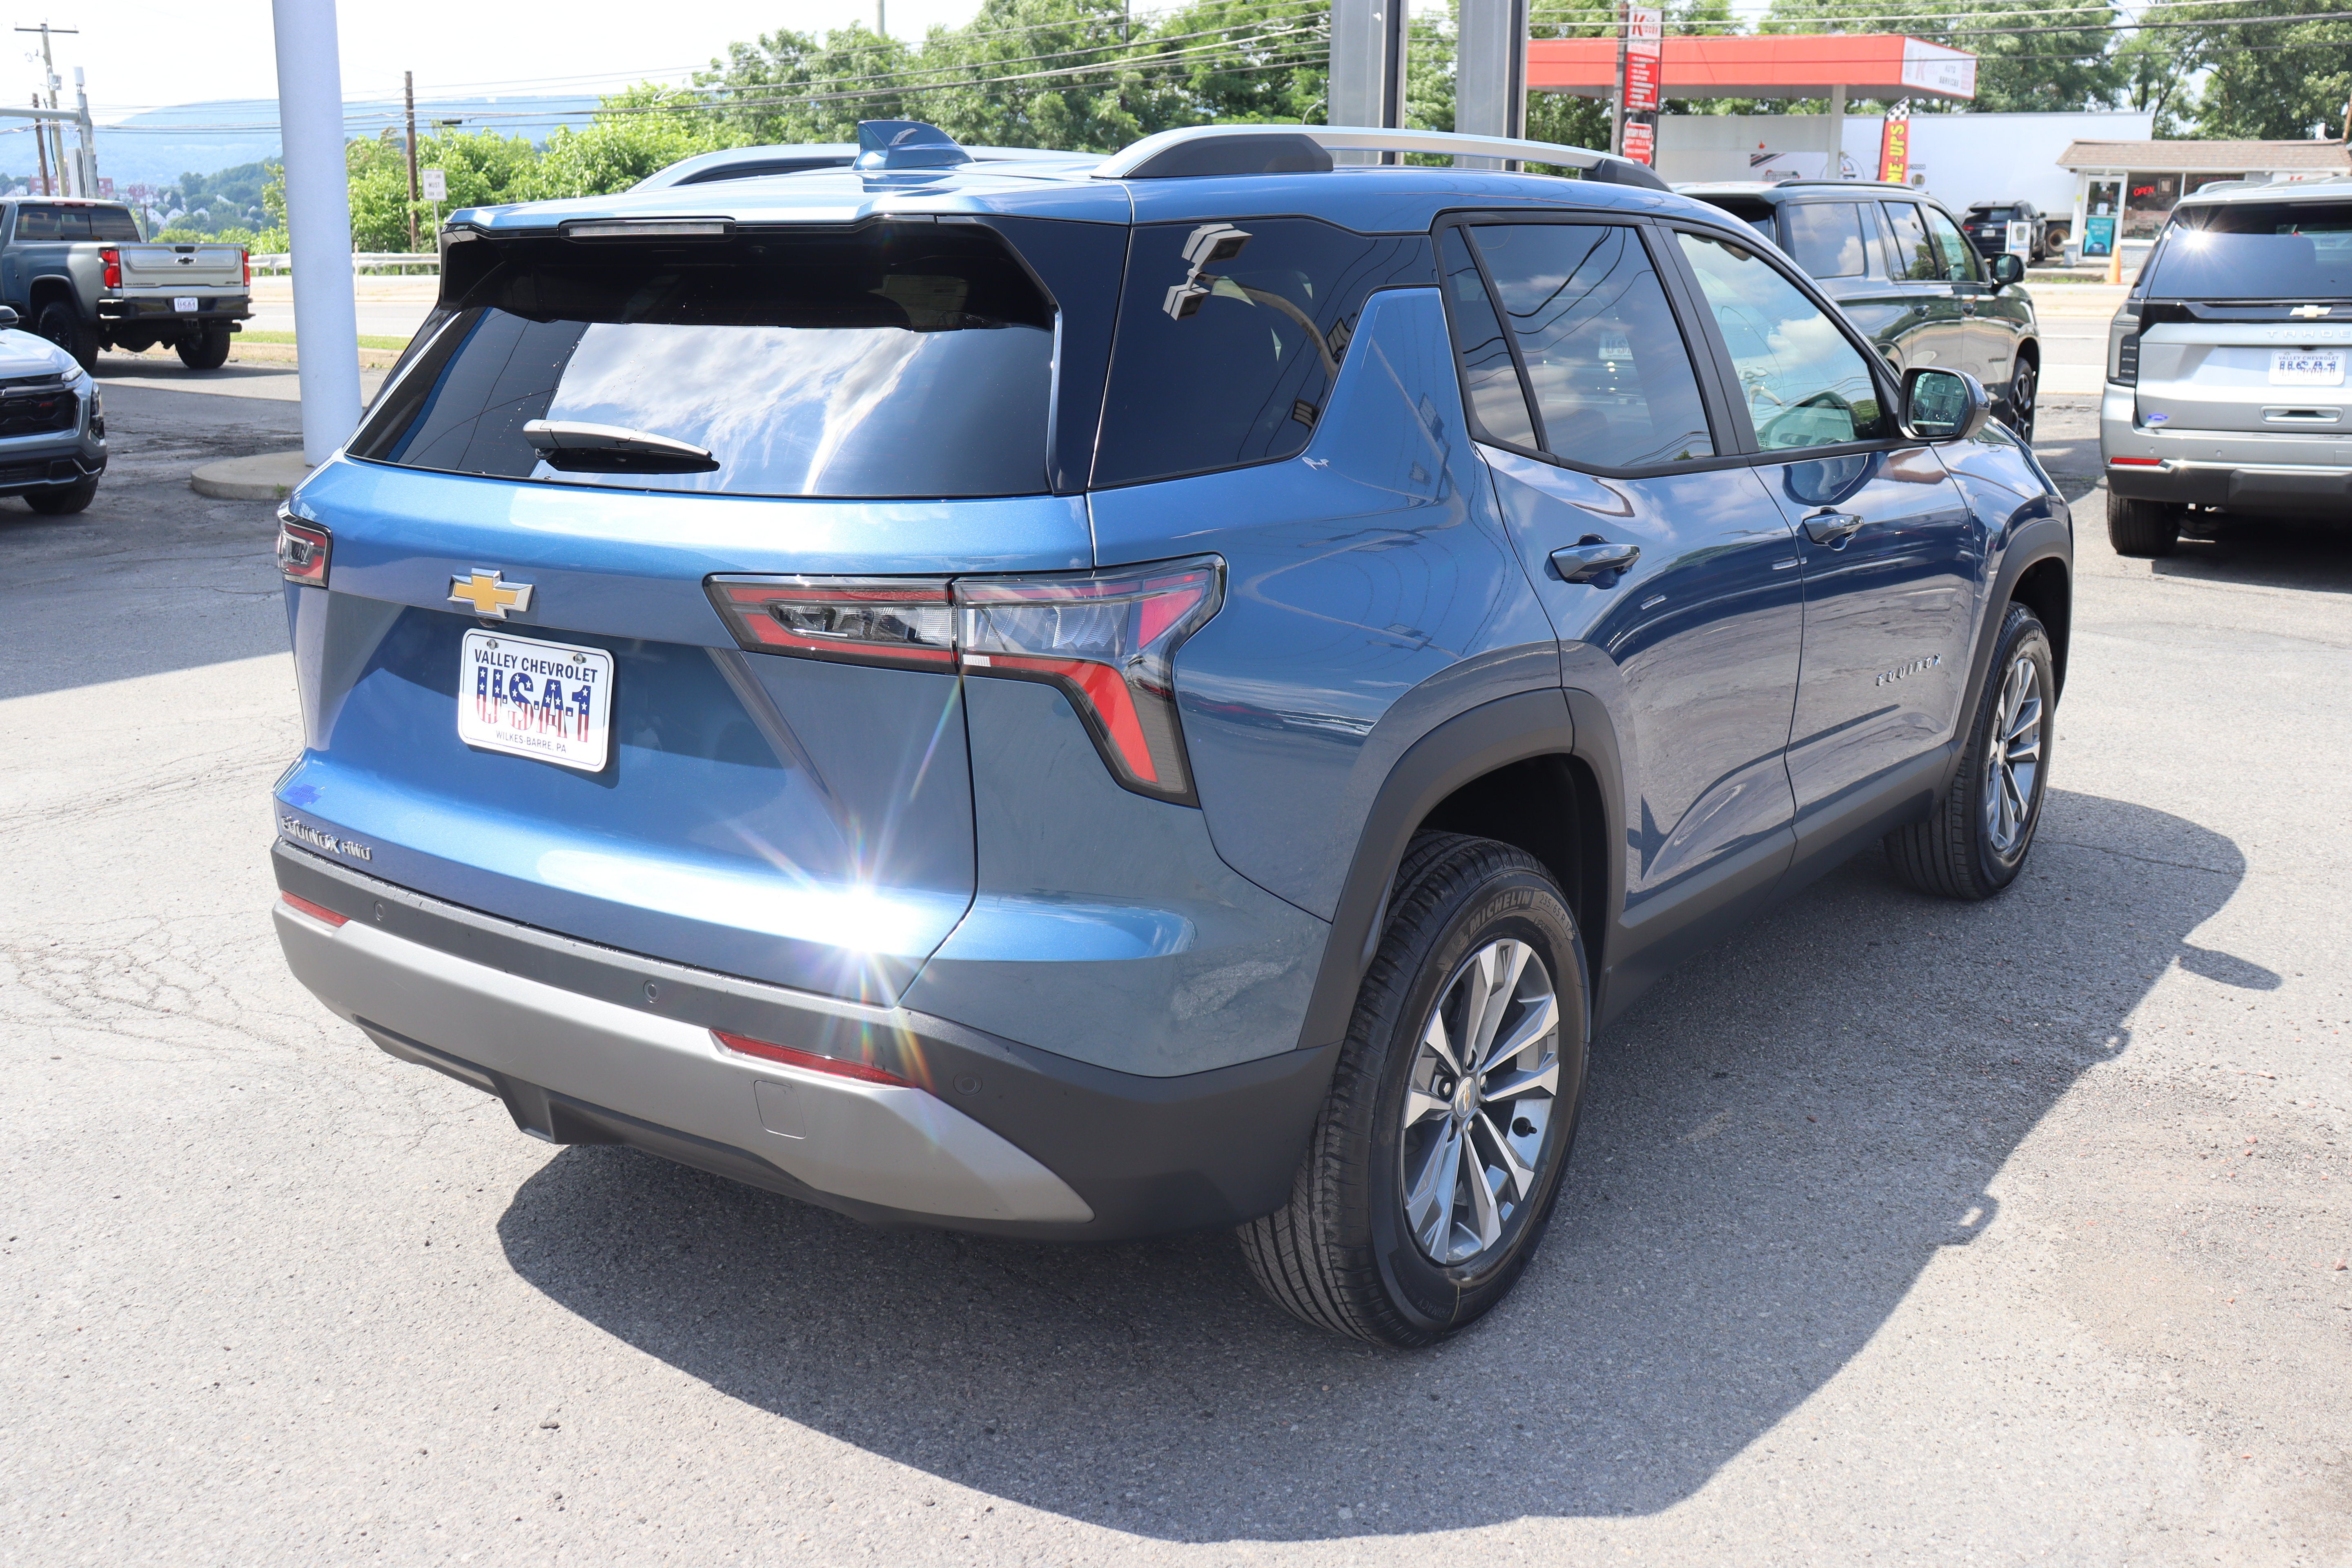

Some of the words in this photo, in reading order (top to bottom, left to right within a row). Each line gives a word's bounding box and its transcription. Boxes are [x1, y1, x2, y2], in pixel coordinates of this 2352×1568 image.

[2133, 186, 2155, 197] OPEN
[474, 648, 518, 669] VALLEY
[521, 657, 598, 684] CHEVROLET
[556, 743, 567, 753] PA
[282, 815, 341, 854] EQUINOX
[341, 841, 372, 860] AWD
[1470, 891, 1532, 936] MICHELIN
[1539, 894, 1561, 917] 235/65
[1560, 914, 1566, 924] R
[1566, 921, 1572, 932] 17
[1417, 1297, 1451, 1319] PRIMACY
